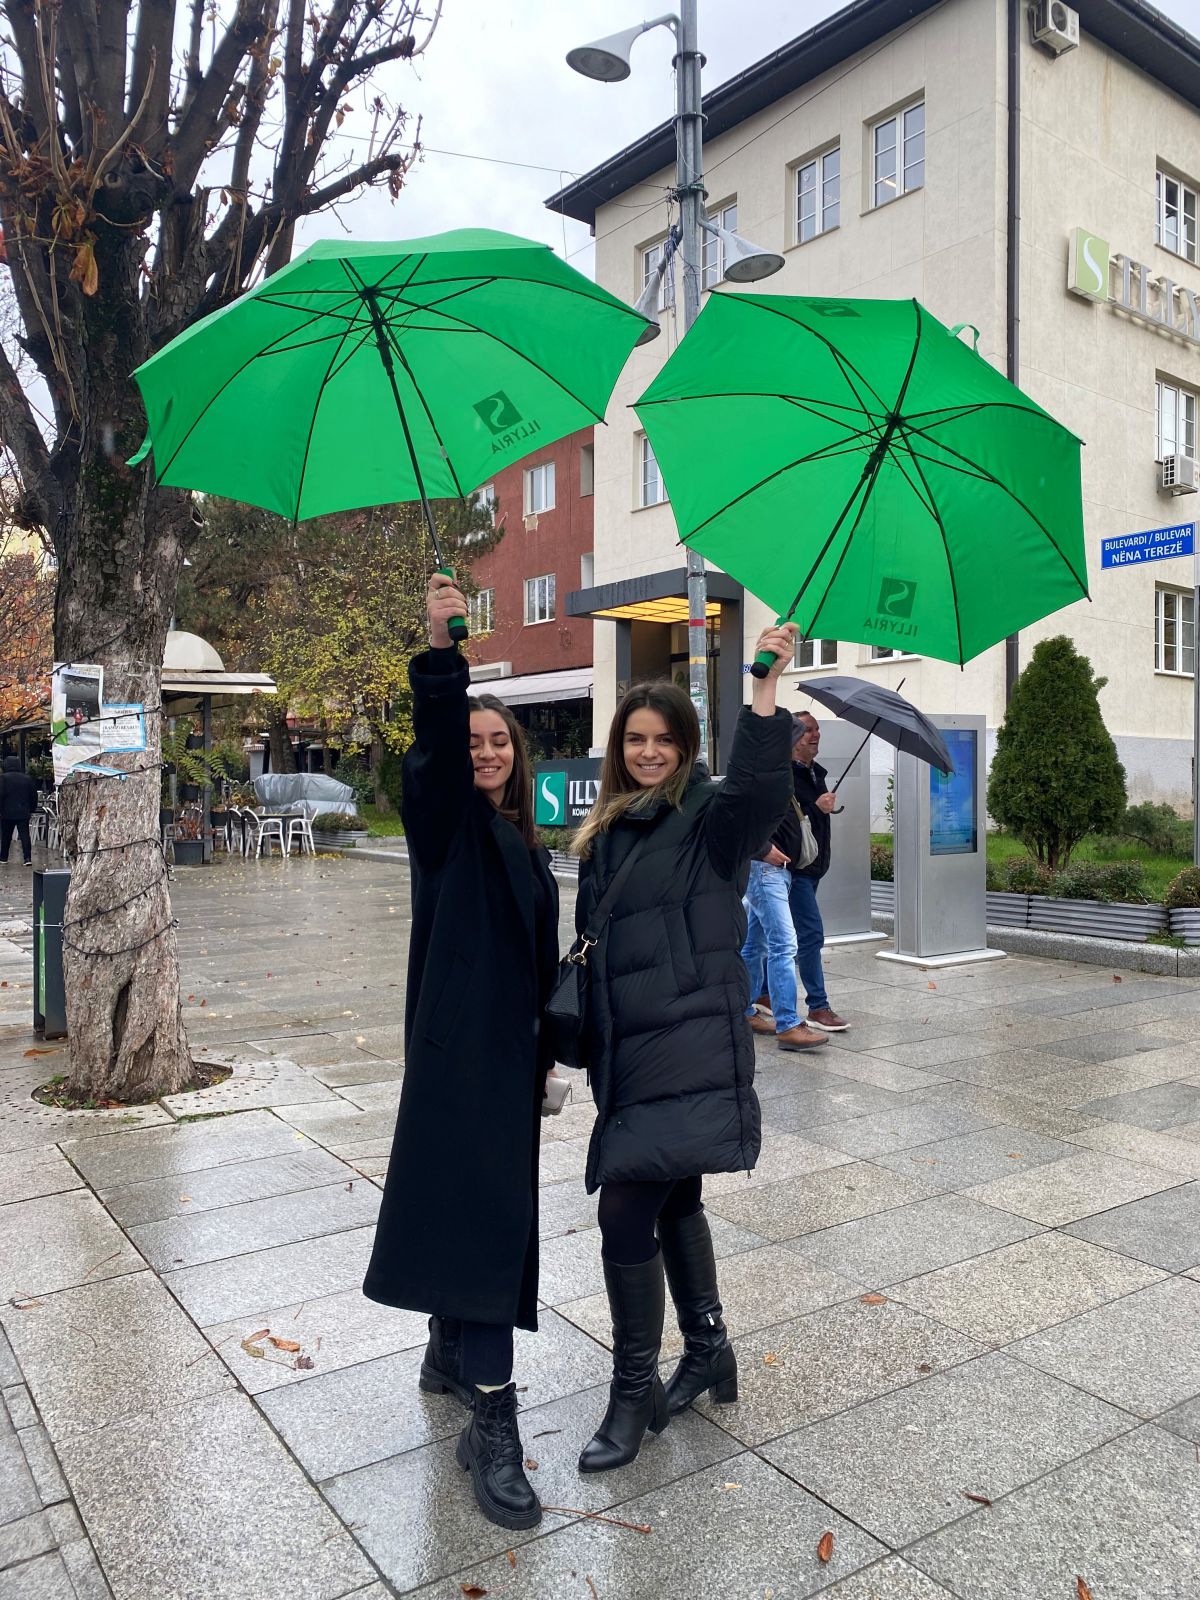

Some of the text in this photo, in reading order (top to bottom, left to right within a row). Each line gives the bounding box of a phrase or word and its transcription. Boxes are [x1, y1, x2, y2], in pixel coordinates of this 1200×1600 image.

[1105, 535, 1147, 551] BULEVARDI
[1155, 527, 1191, 542] BULEVAR
[1111, 540, 1183, 564] NËNA TEREZË
